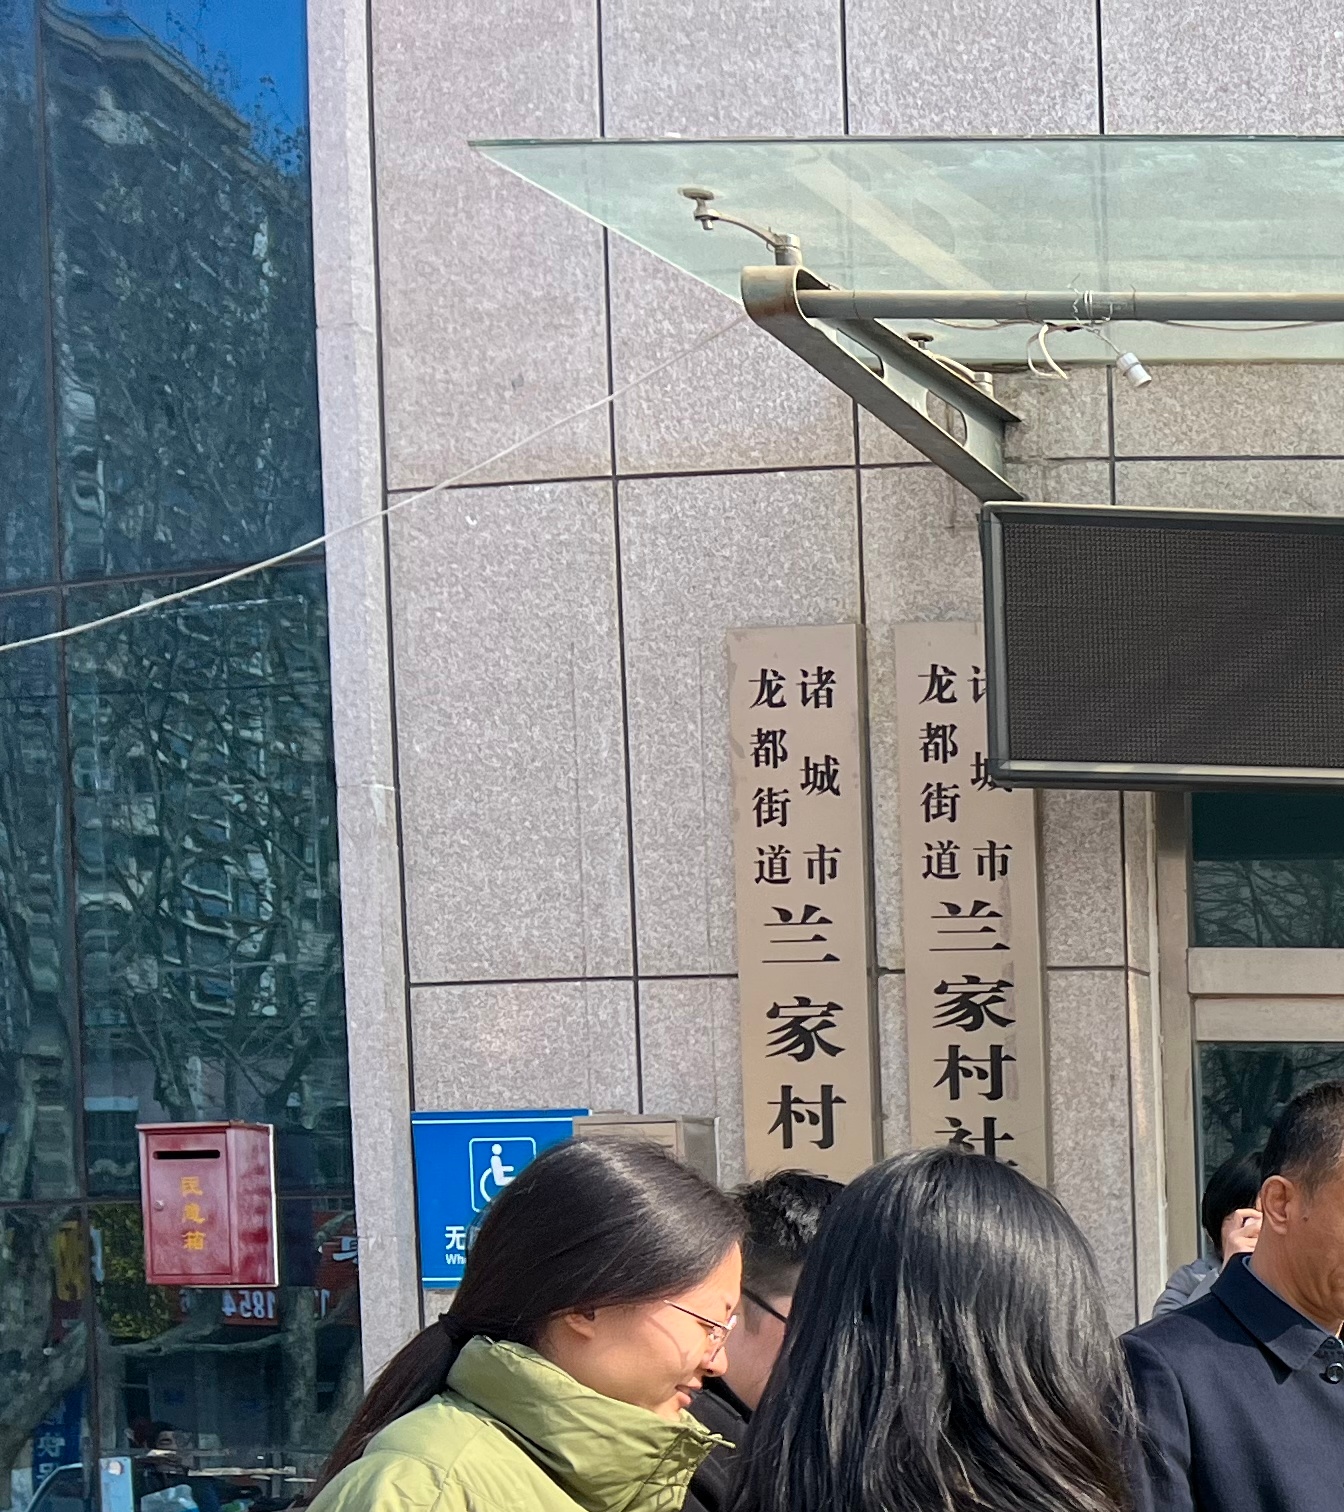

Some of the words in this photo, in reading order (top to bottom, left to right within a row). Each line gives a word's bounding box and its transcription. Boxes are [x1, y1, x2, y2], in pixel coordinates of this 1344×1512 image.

[748, 668, 791, 886] 龙都街道
[796, 666, 842, 885] 诸城市
[919, 664, 961, 881] 龙都街道
[762, 904, 847, 1151] 兰家村
